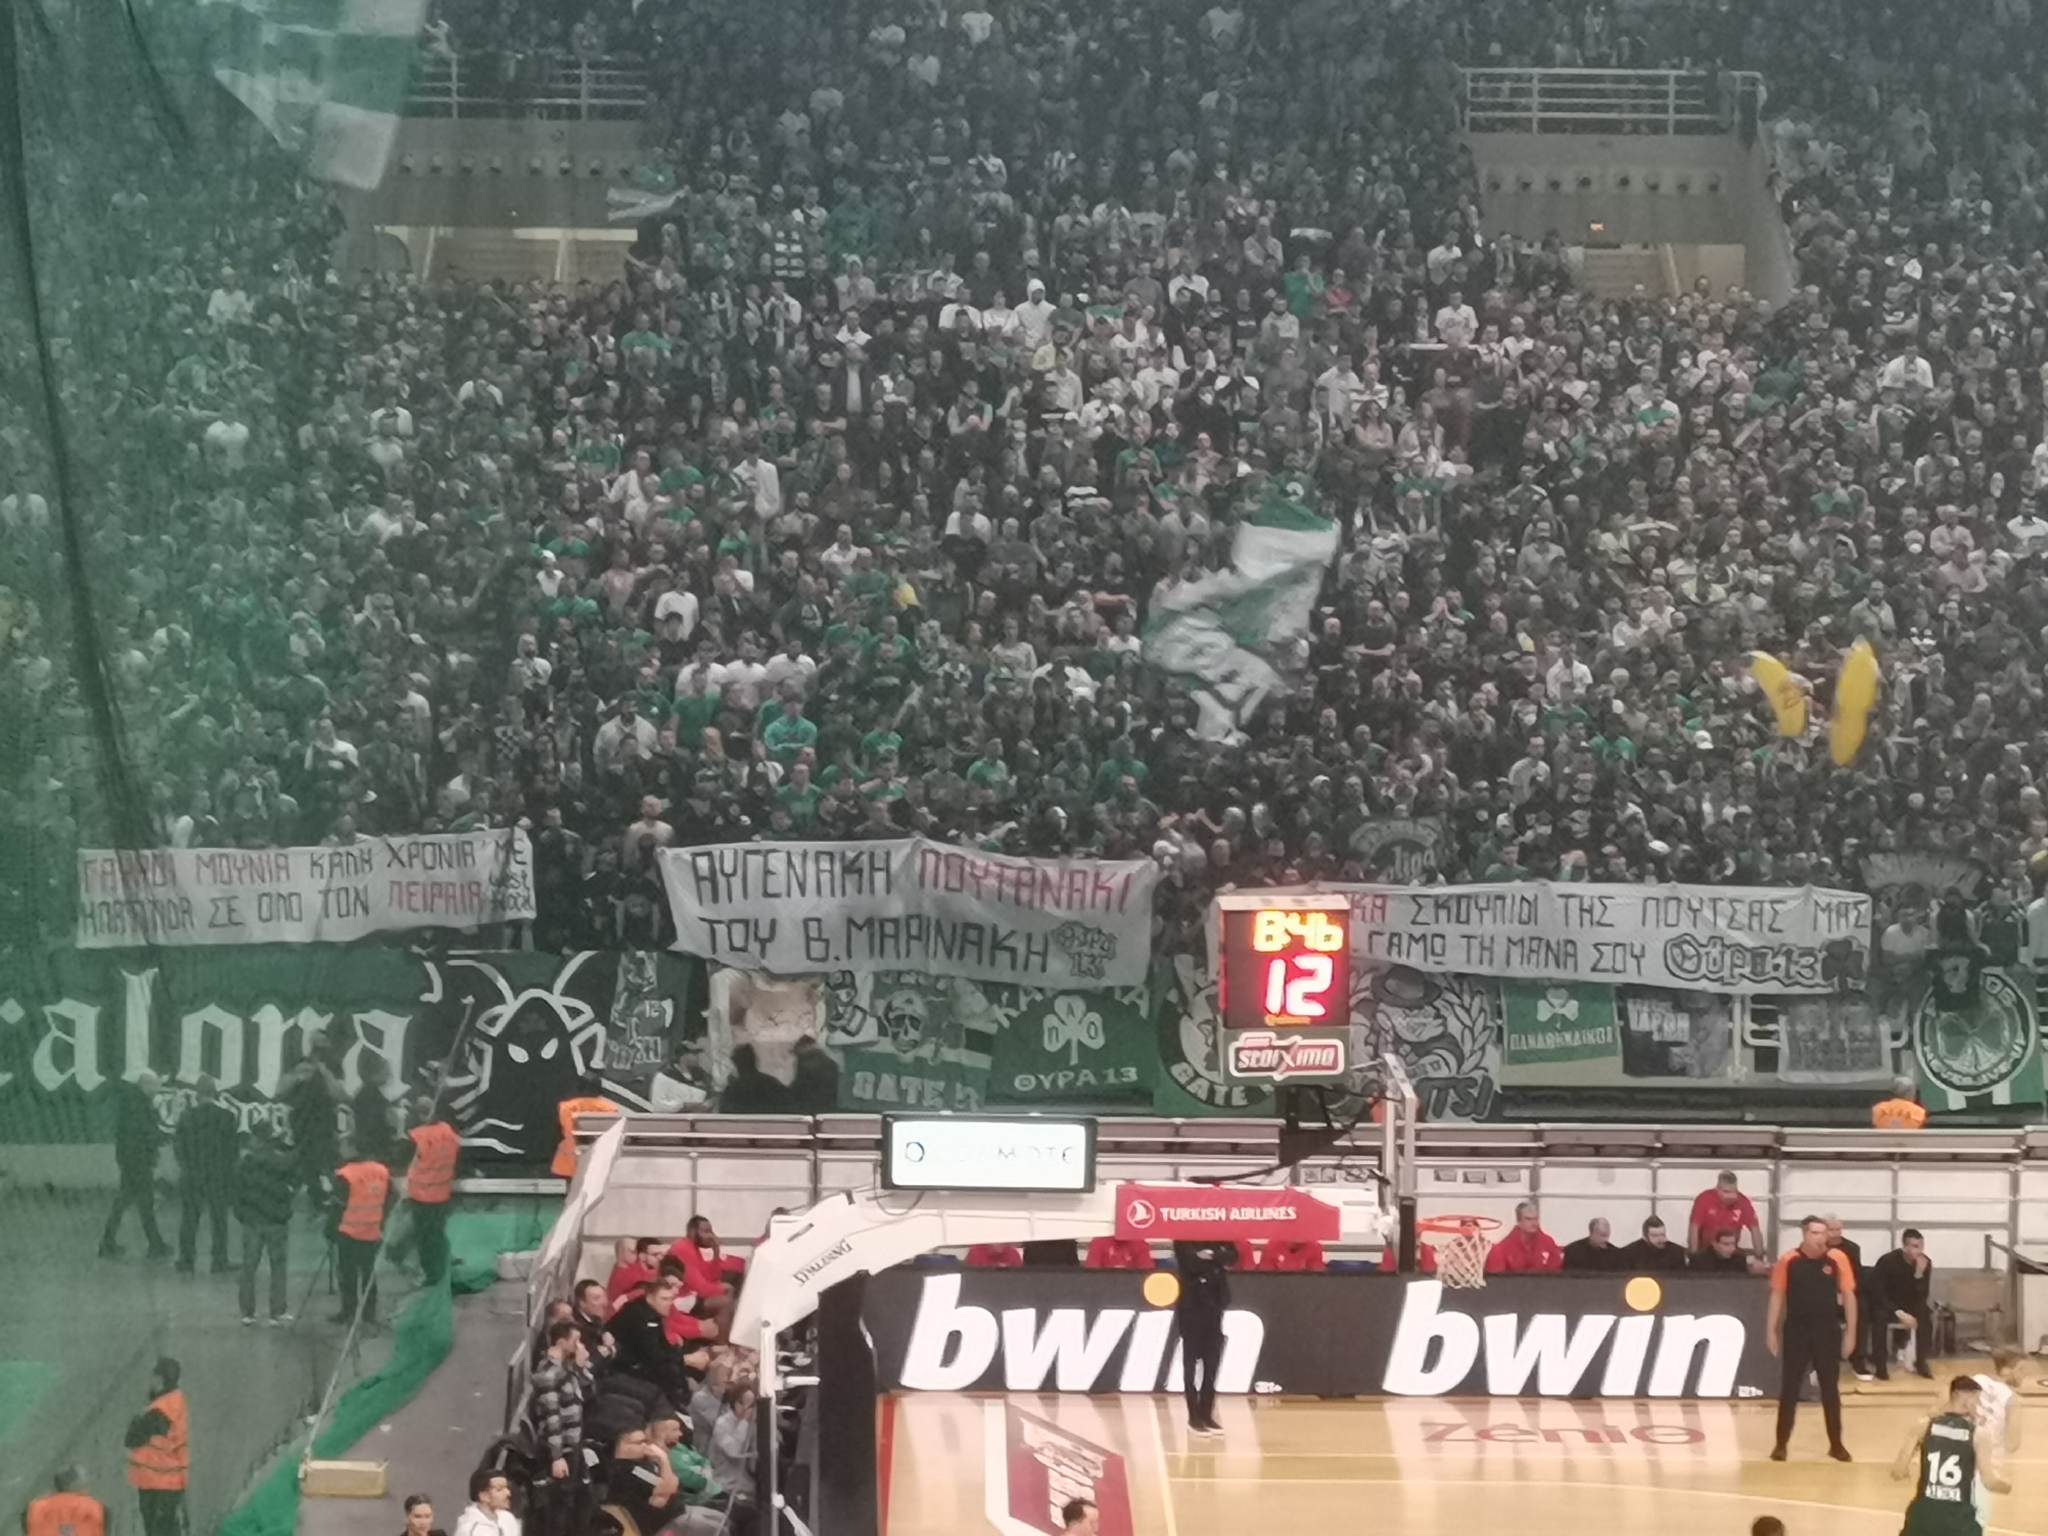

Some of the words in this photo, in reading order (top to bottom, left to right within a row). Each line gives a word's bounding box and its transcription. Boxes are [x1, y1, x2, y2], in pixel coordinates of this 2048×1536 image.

[196, 853, 290, 885] ΜΟΥΝΙΑ
[386, 840, 476, 870] ΧΡΟΝΙΑ
[691, 849, 892, 905] ΑΥΓΕΝΑΚΗ
[919, 849, 1135, 916] ΠΟΥΤΑΝΑΚΙ
[208, 896, 244, 928] ΣΕ
[318, 884, 370, 919] ΤΟΝ
[388, 881, 484, 915] ΠΕΙΡΑΙΑ
[1557, 894, 1615, 928] ΤΗΣ
[698, 916, 777, 960] ΤΟΥ
[1367, 931, 1447, 966] ΓΑΜΩ
[1460, 934, 1494, 966] ΤΗ
[1506, 936, 1578, 972] ΜΑΝΑ
[1590, 940, 1646, 976] ΣΟΥ
[1265, 953, 1333, 1016] 12
[0, 967, 414, 1102] alora
[1014, 1069, 1098, 1092] ΘΥΡΑ
[1103, 1066, 1139, 1085] 13
[1160, 1207, 1226, 1222] TURKISH
[1230, 1206, 1297, 1221] AIRLINES
[901, 1272, 1265, 1393] bwin
[1382, 1276, 1745, 1397] bwin
[1927, 1451, 1962, 1487] 16
